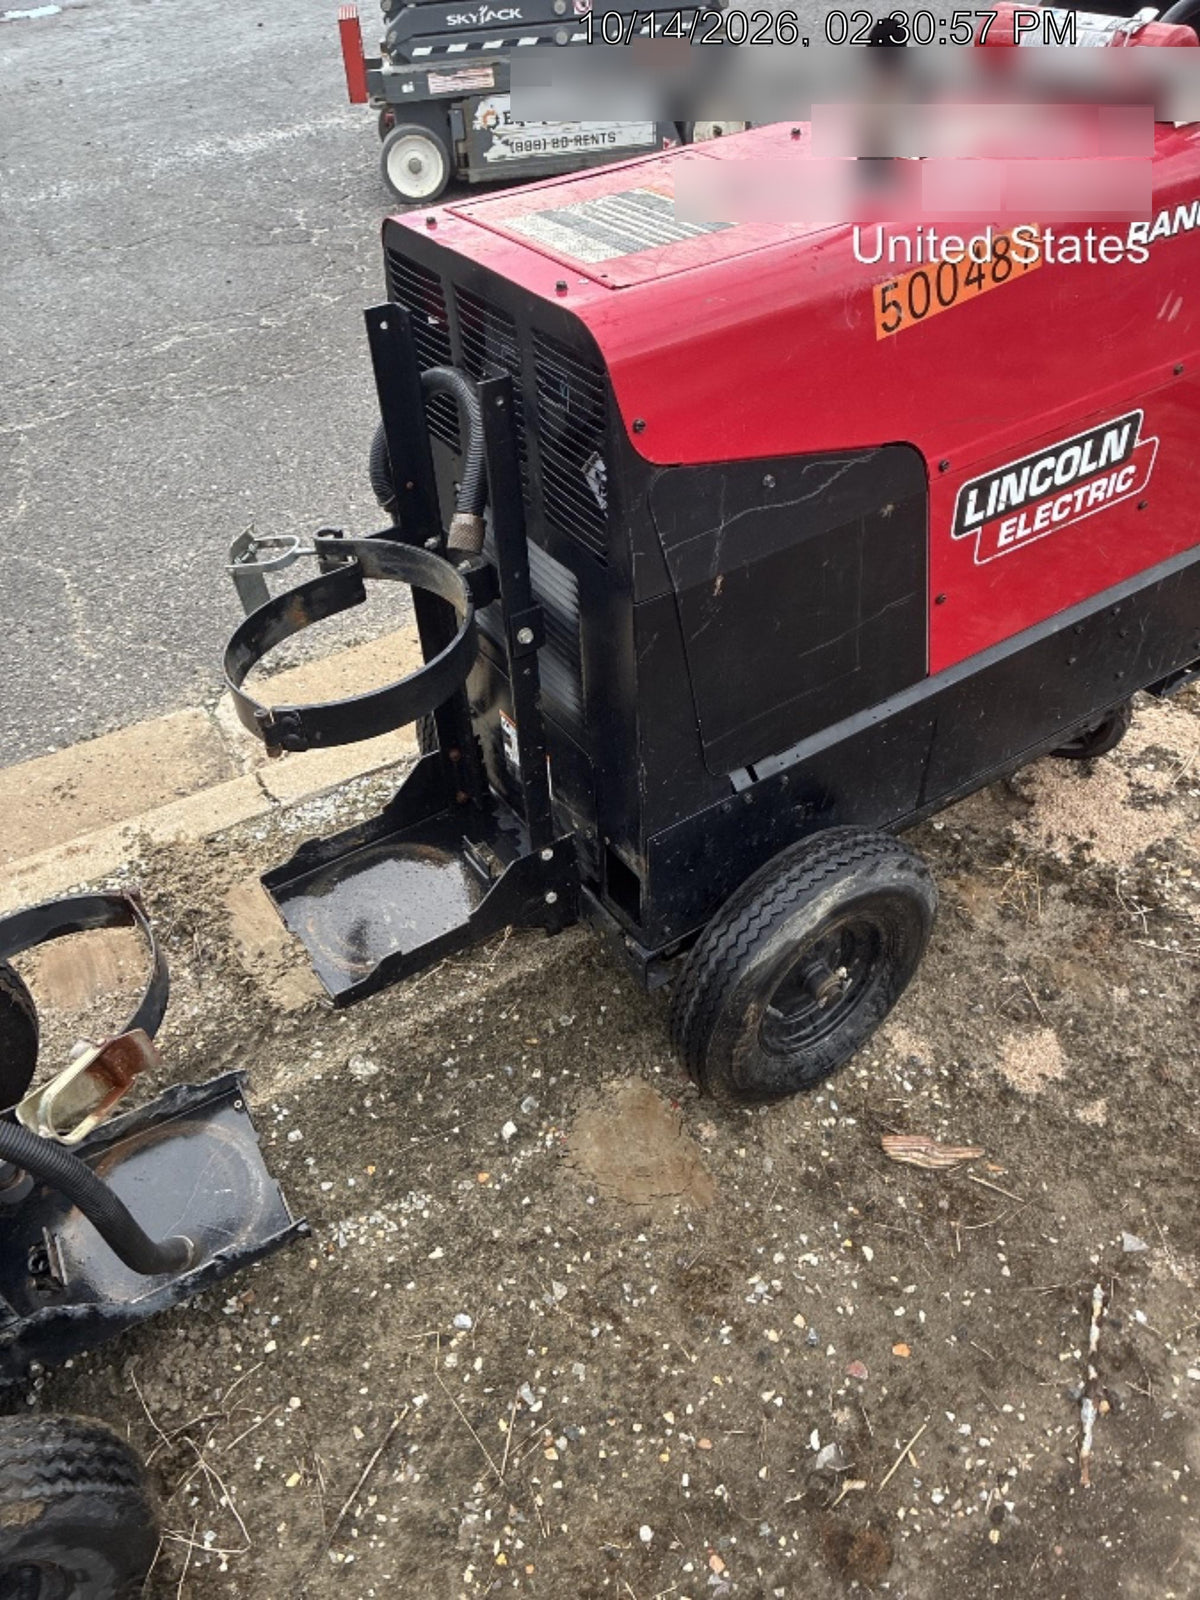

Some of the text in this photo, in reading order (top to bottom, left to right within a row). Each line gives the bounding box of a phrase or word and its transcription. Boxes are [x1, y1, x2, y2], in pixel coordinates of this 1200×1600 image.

[446, 5, 523, 26] SKYJACK
[1126, 200, 1200, 249] RAN
[963, 423, 1132, 527] LINCOLN
[996, 464, 1137, 548] ELECTRIC
